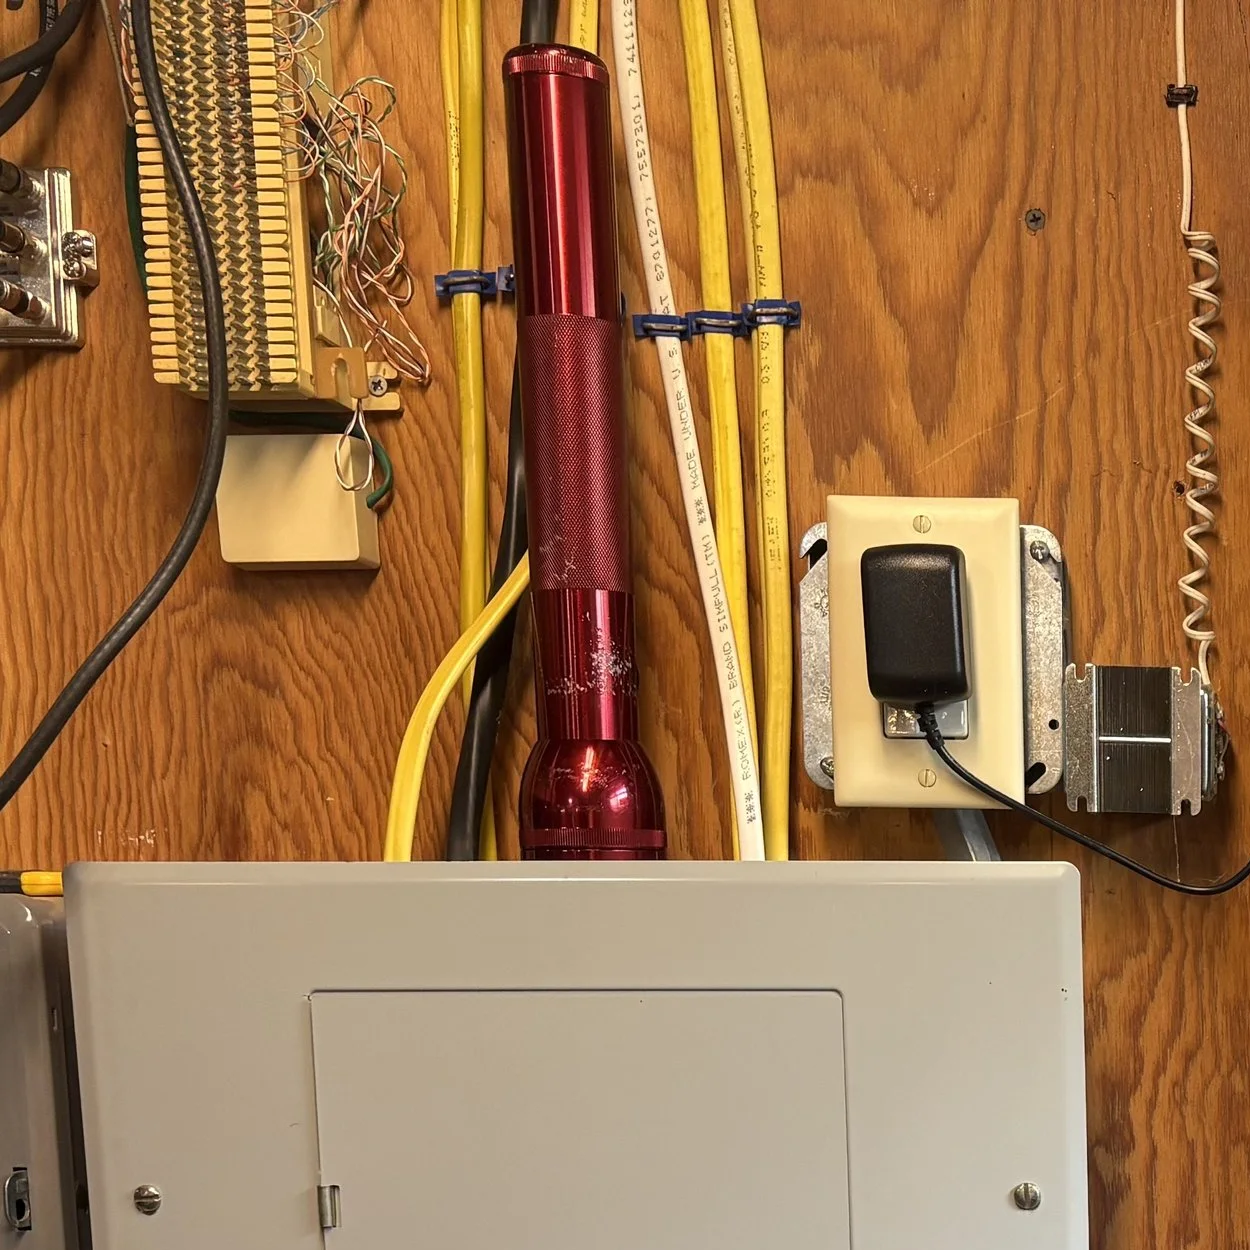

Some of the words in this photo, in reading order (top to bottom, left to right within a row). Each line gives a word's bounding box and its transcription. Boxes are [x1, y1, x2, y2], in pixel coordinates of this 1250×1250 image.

[676, 387, 690, 441] UNDER
[686, 449, 700, 490] MADE
[723, 641, 738, 691] BRAND
